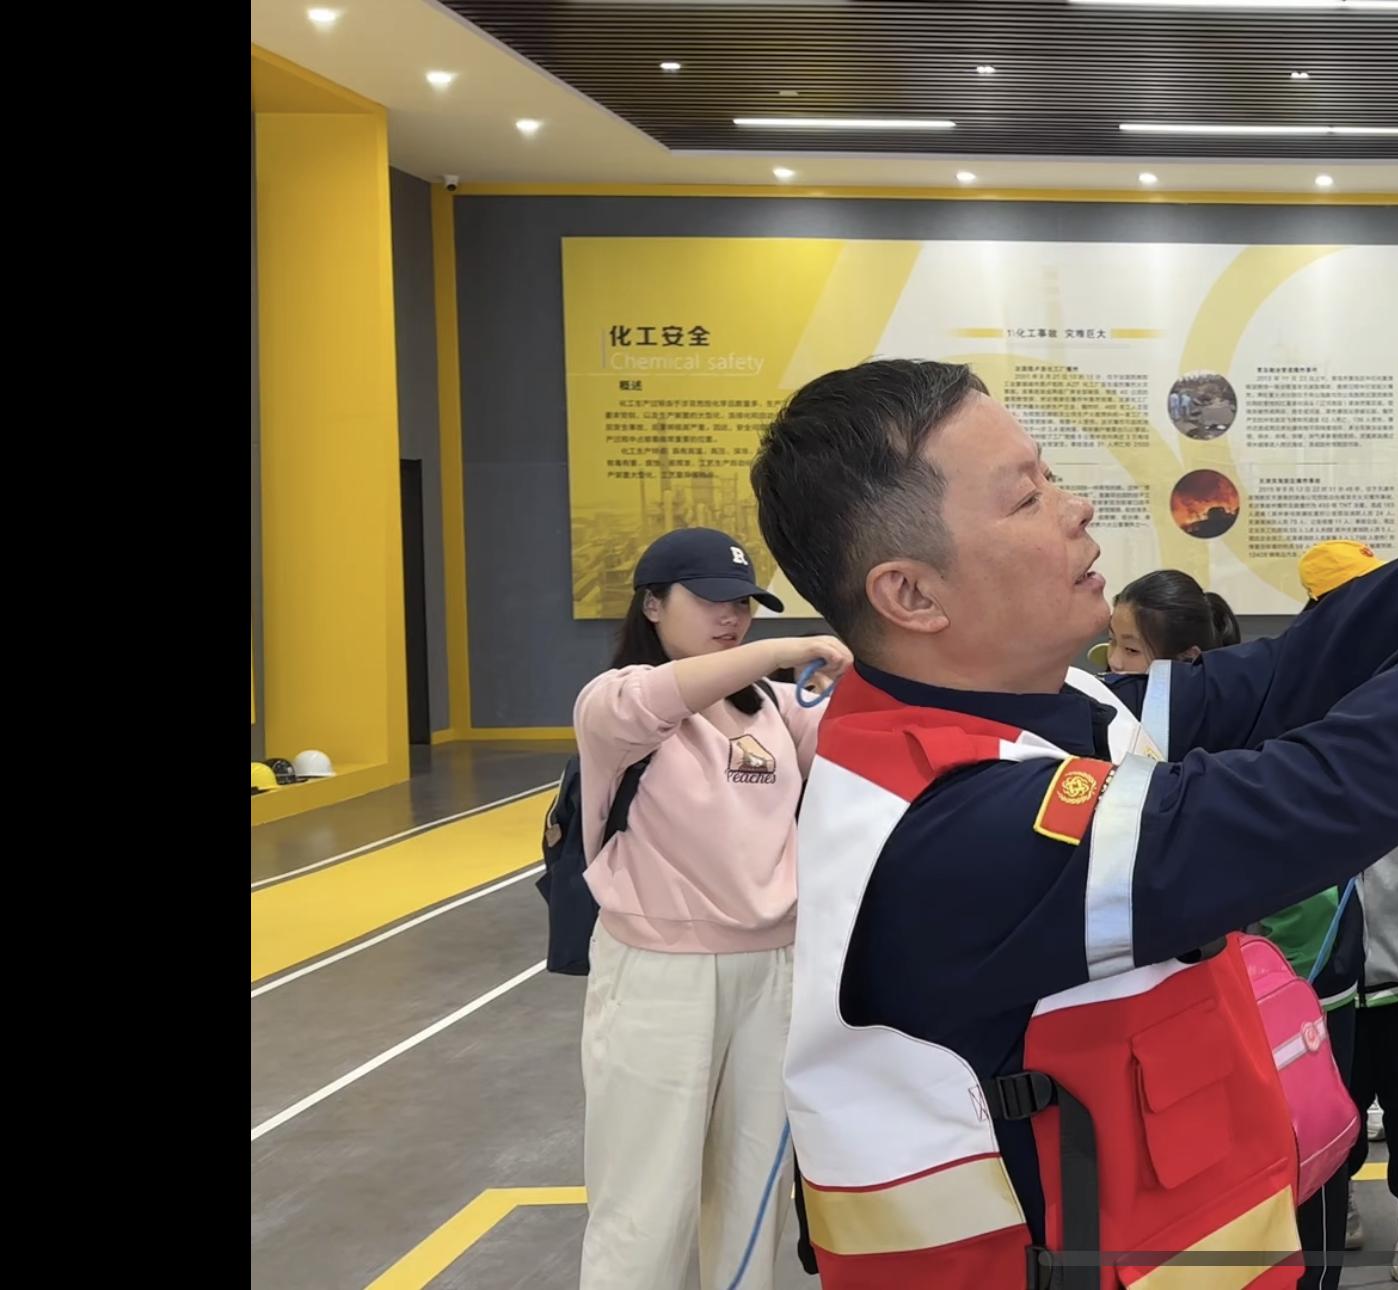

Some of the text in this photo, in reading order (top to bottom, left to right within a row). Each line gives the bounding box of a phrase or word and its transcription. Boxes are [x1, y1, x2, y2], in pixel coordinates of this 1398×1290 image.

[610, 325, 711, 347] 化工安全
[1064, 328, 1107, 339] 灾难巨大
[610, 352, 765, 375] Chemical safety
[618, 379, 643, 391] 概述
[725, 768, 777, 785] Peaches
